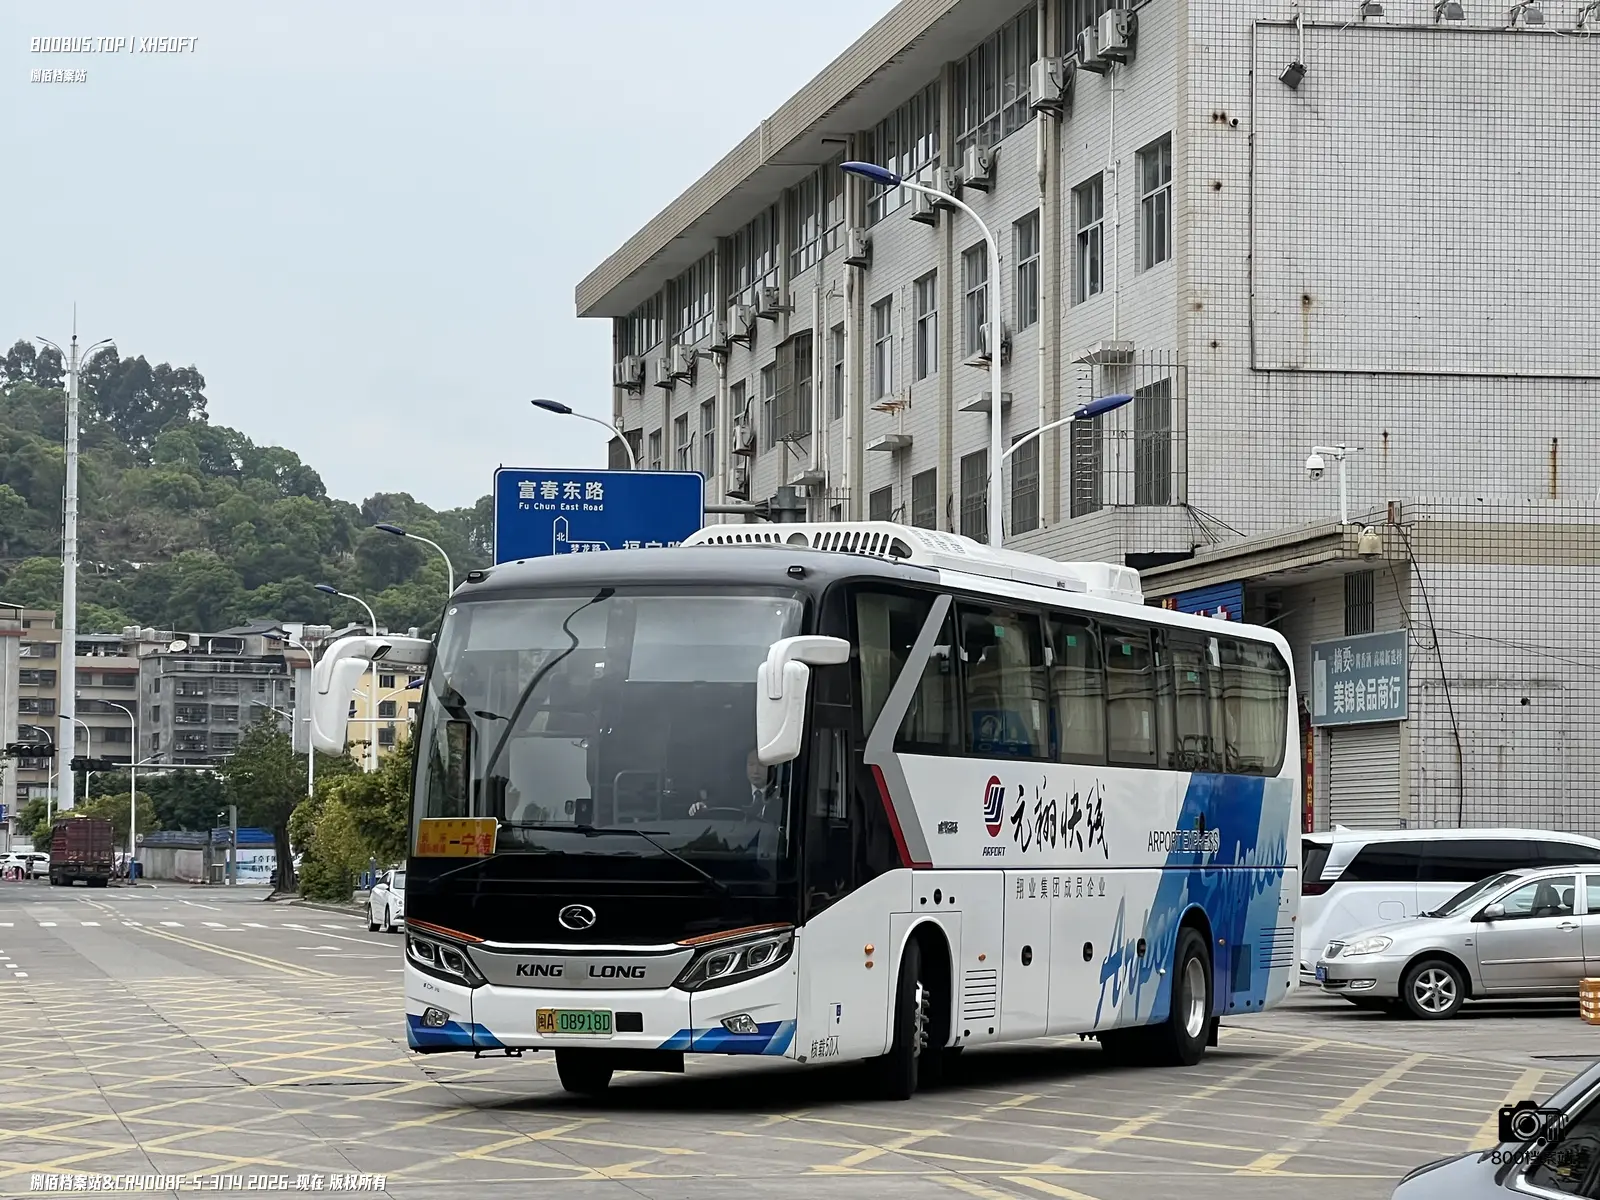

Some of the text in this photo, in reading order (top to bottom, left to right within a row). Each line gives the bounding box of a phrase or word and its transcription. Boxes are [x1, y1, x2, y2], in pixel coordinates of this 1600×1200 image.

[517, 480, 605, 501] 富春东路
[518, 502, 604, 511] Fu Chun East Road
[556, 532, 566, 542] 北
[1333, 675, 1401, 715] 美锦食品商行
[1010, 774, 1109, 860] 元翔快线
[1015, 876, 1106, 900] 翔业集团成员企业
[516, 963, 646, 979] KING LONG
